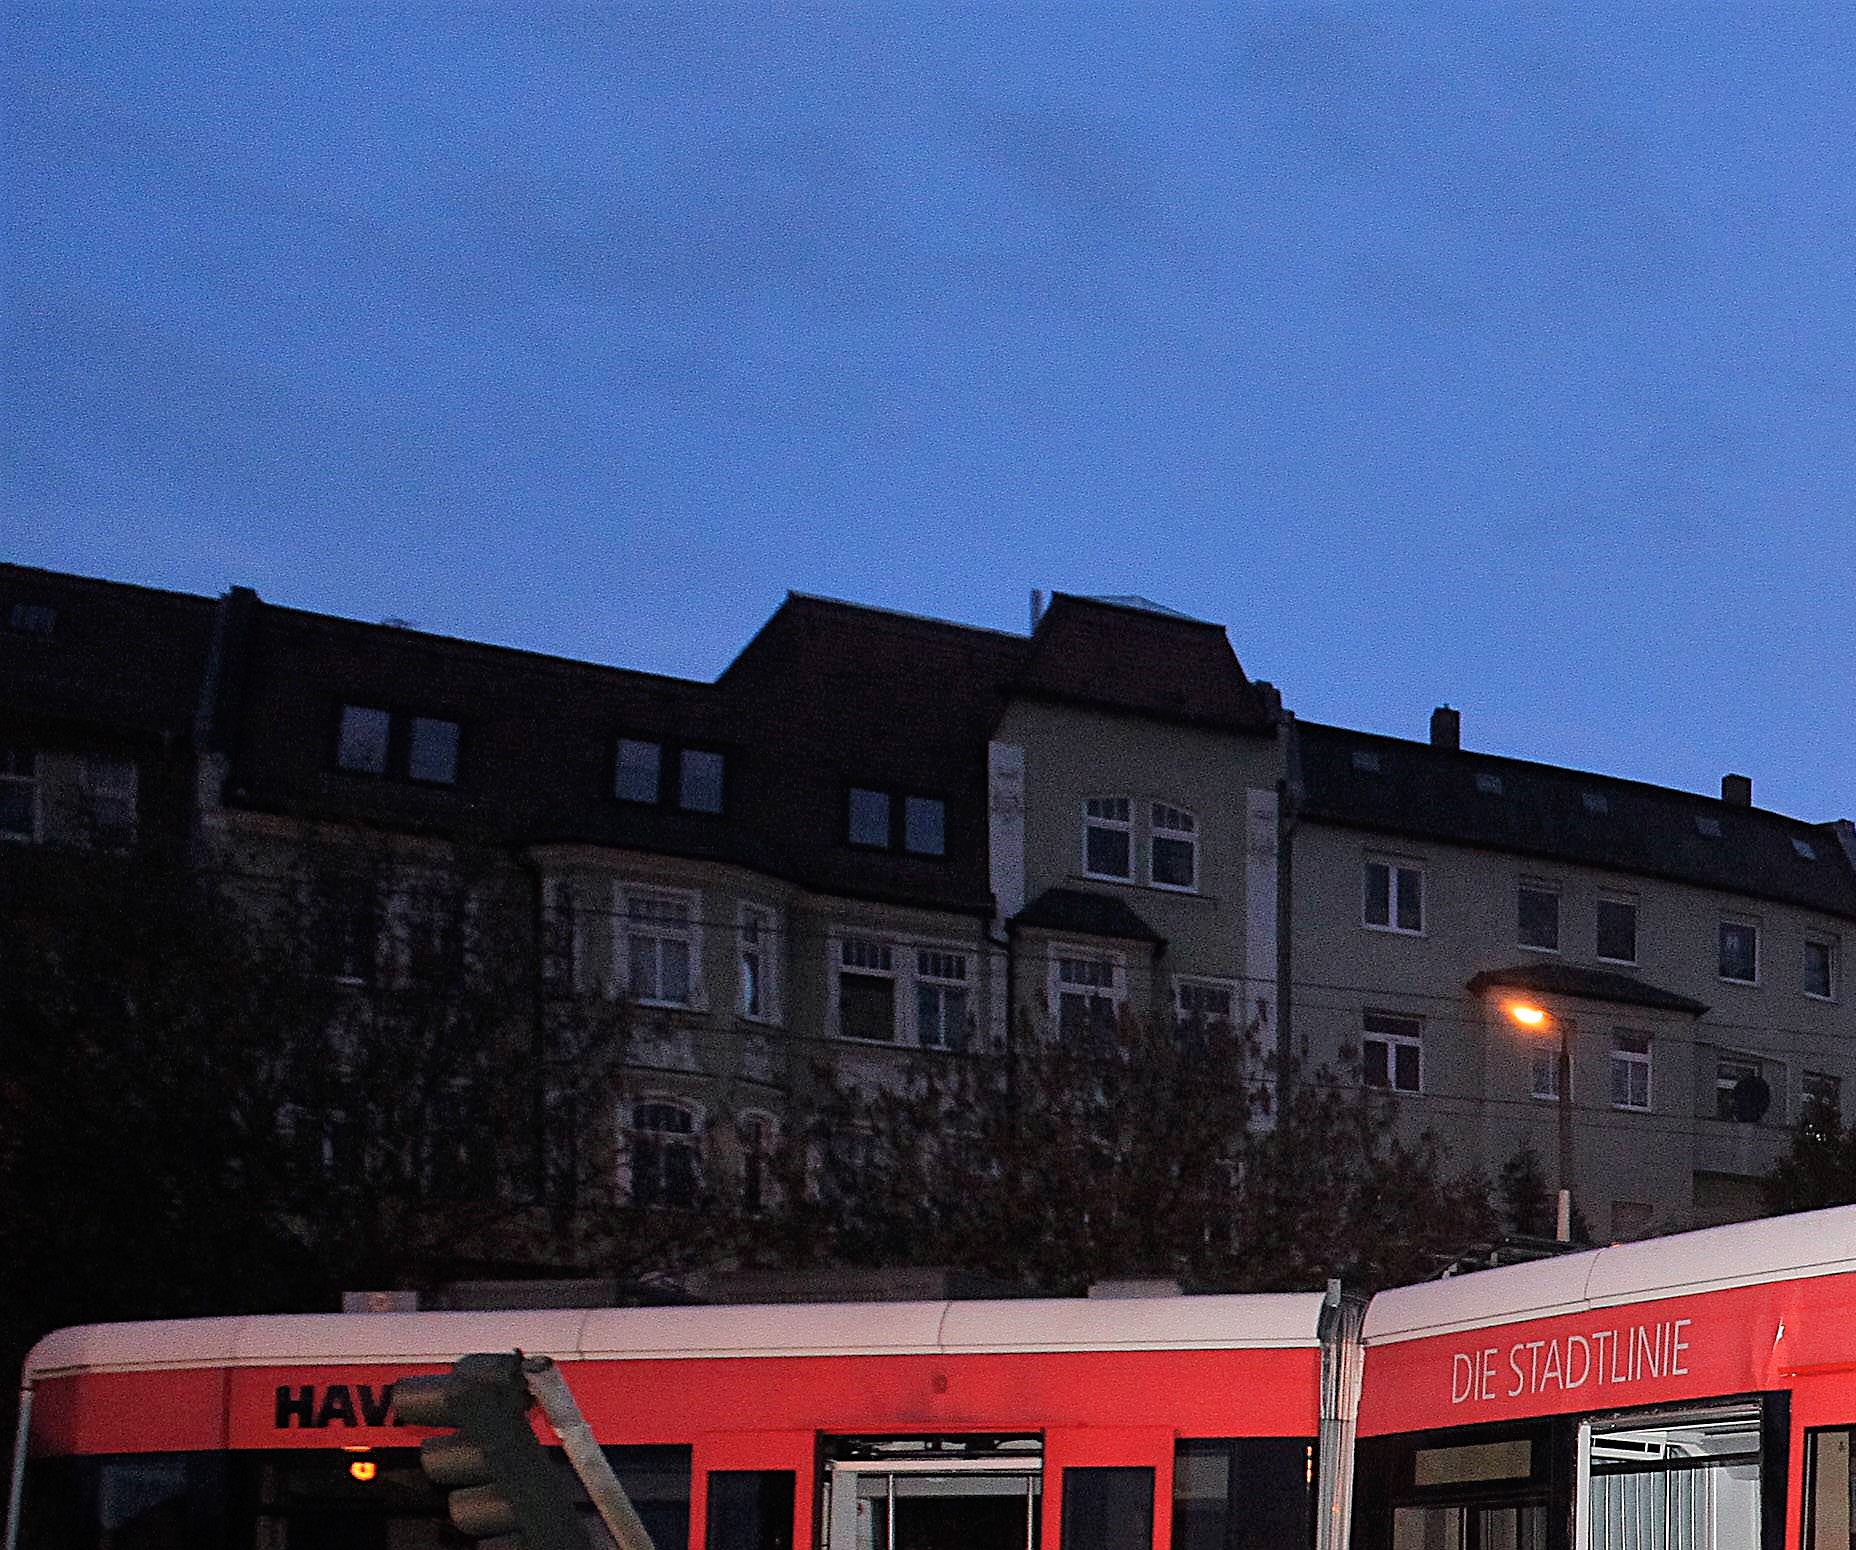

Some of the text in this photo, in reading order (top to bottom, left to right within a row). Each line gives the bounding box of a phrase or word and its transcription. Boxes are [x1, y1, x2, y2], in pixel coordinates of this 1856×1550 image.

[1451, 1318, 1692, 1404] DIE STADTLINIE
[276, 1385, 403, 1428] HAV
